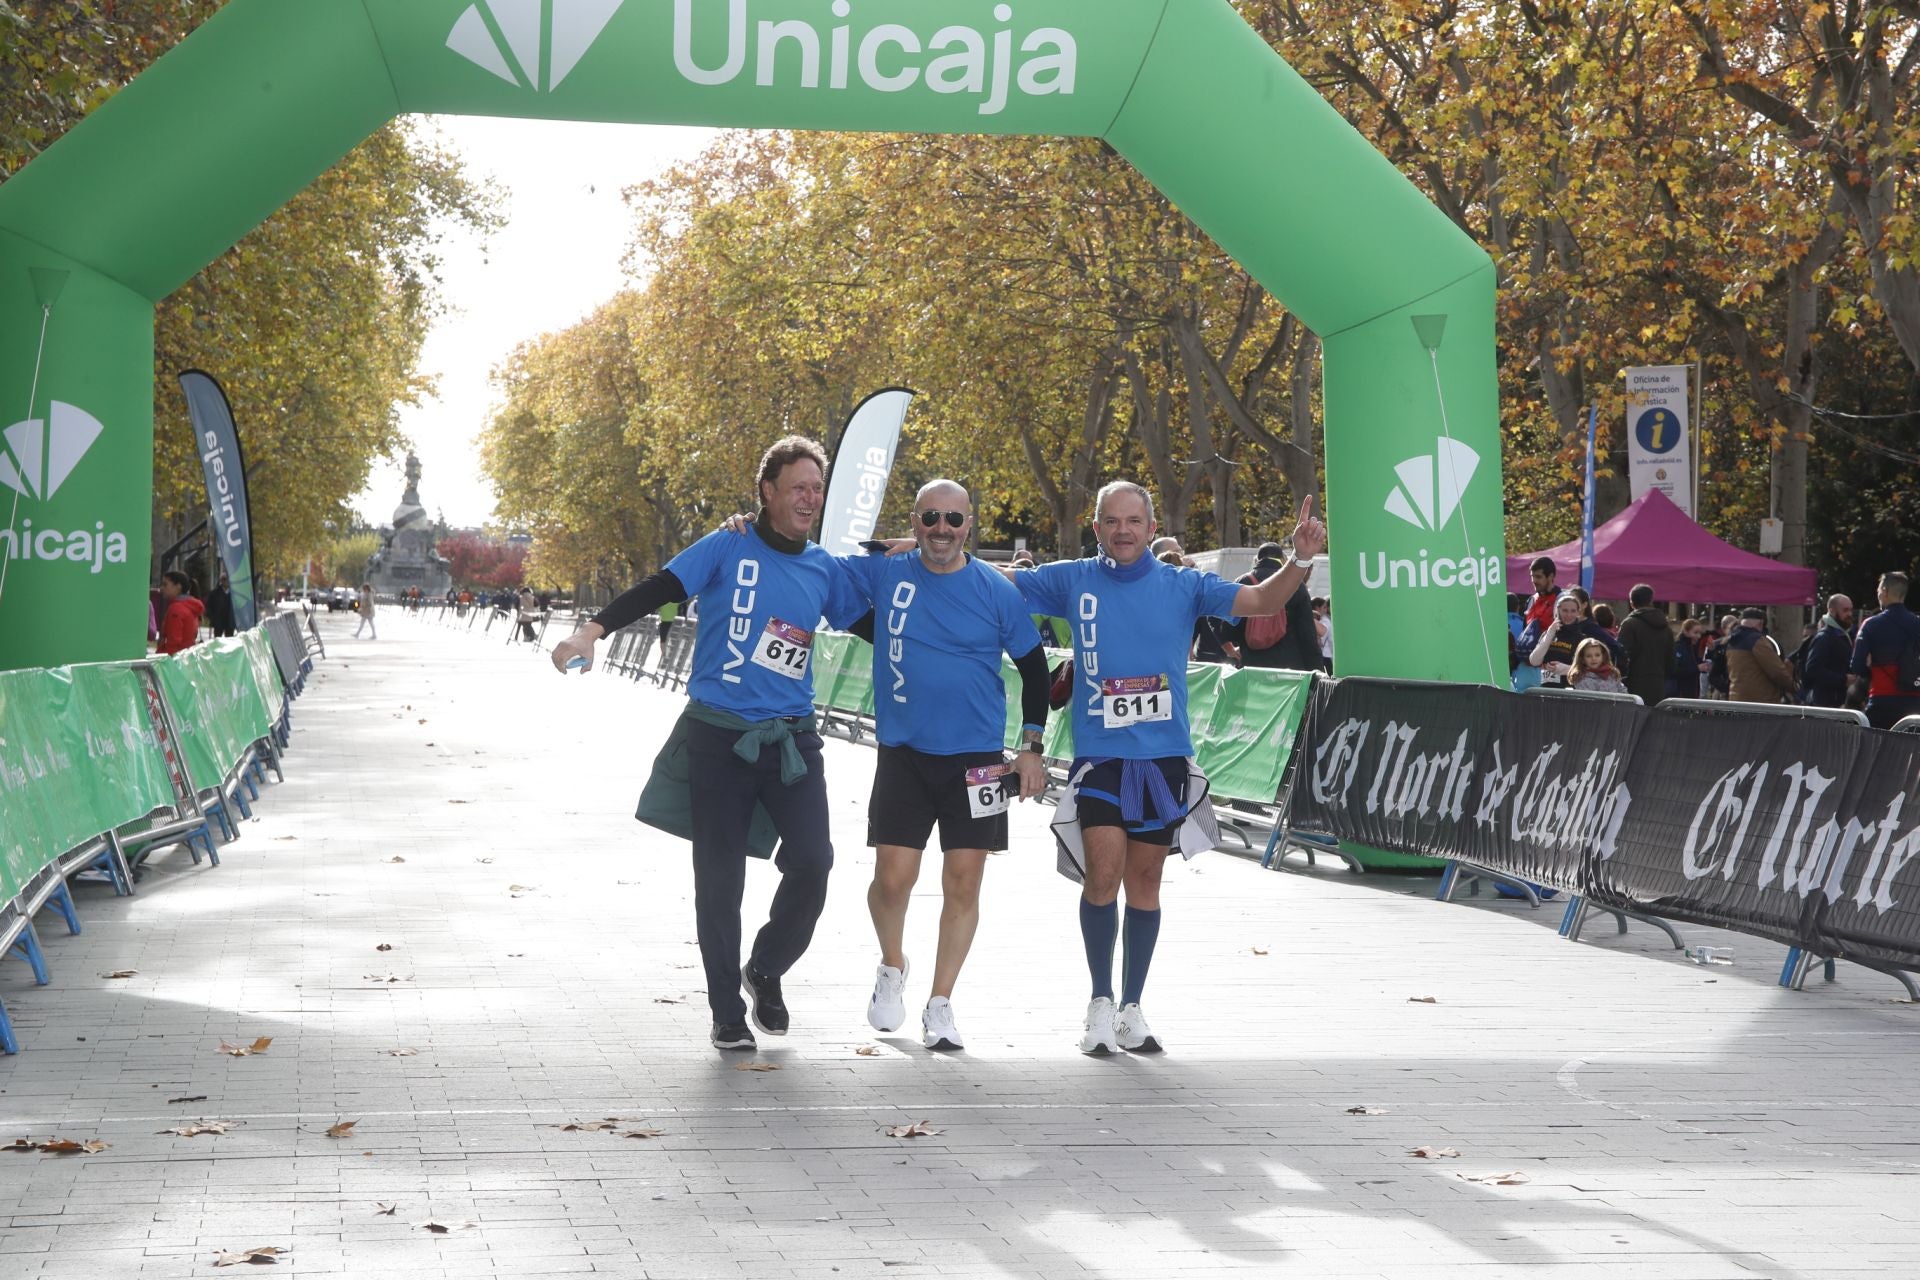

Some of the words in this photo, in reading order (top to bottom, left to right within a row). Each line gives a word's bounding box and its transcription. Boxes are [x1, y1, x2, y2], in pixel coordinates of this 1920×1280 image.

[673, 0, 1077, 115] Unicaja
[1633, 376, 1659, 384] Oficina
[1660, 374, 1671, 383] de
[0, 518, 127, 573] nicaja
[1359, 546, 1501, 597] Unicaja
[722, 559, 759, 684] IVECO
[766, 640, 807, 669] 612
[887, 581, 916, 703] IVECO
[1080, 592, 1104, 716] IVECO
[1113, 695, 1159, 717] 611
[979, 785, 1004, 806] 61
[1312, 718, 1370, 809] El
[1366, 720, 1474, 823] Norte
[1683, 760, 1769, 881] El
[1758, 761, 1920, 916] Norte
